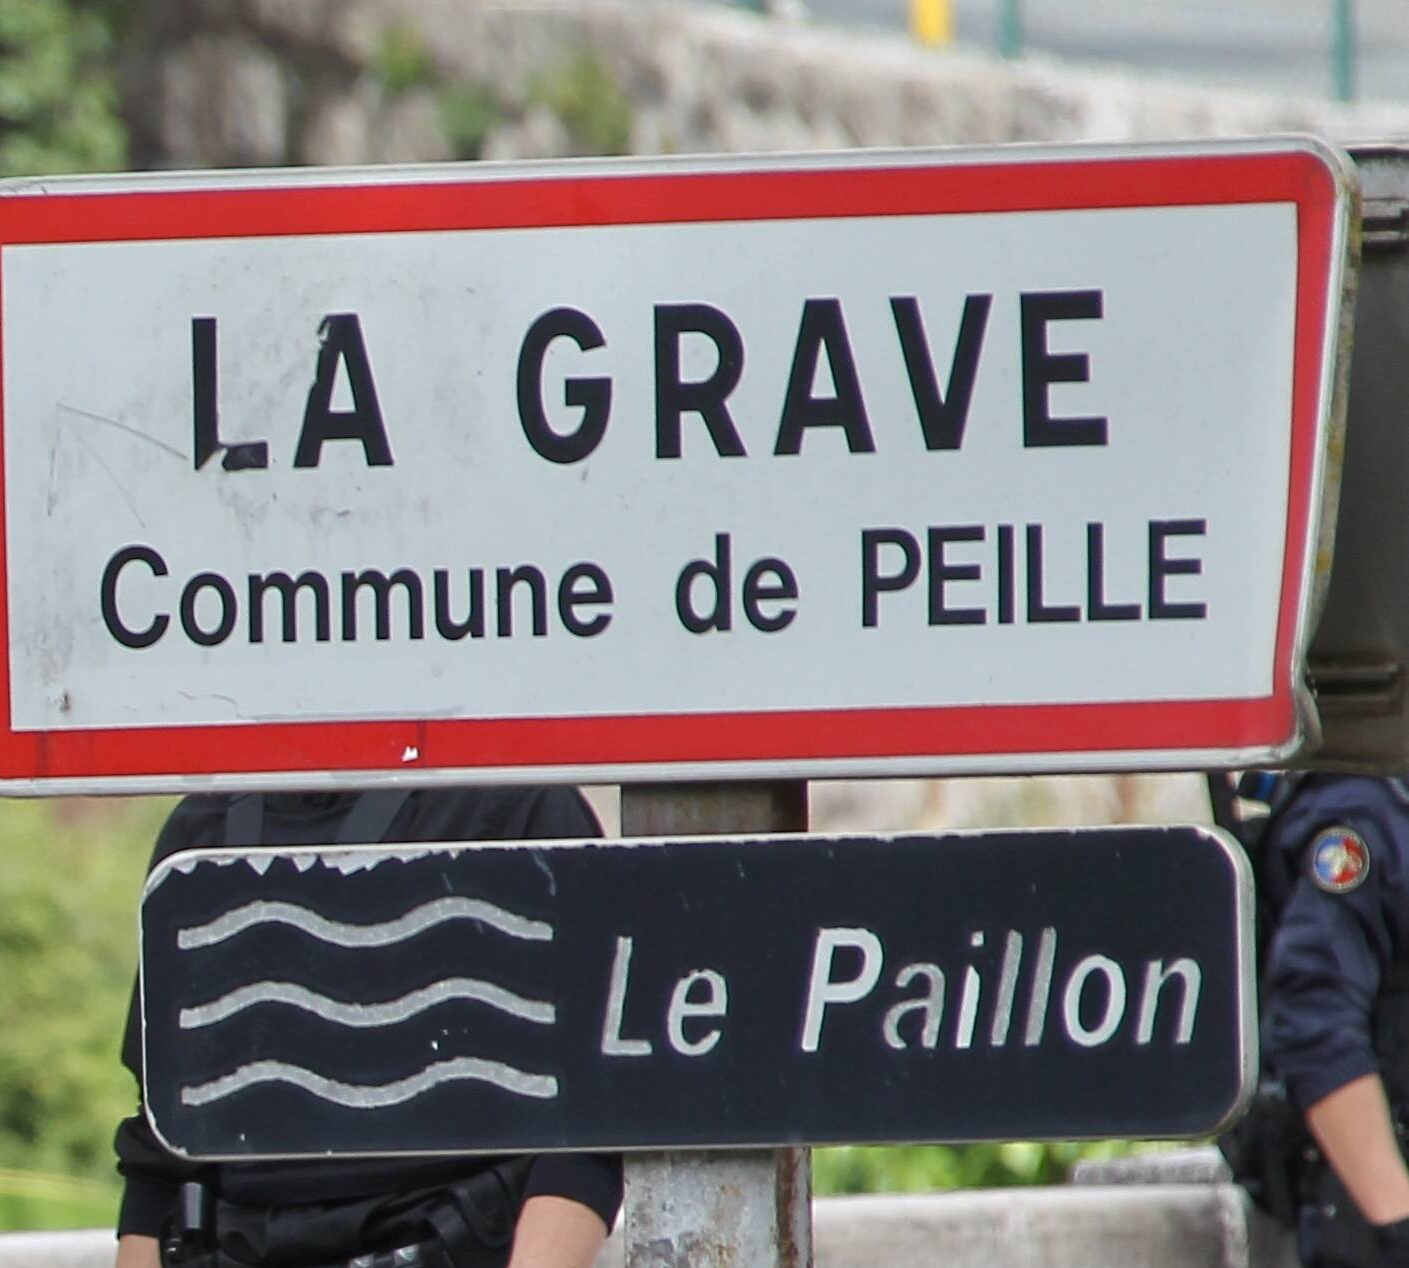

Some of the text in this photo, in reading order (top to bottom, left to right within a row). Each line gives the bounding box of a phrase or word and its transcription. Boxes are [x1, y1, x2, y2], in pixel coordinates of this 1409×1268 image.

[190, 289, 1109, 474] LA GRAVE
[99, 519, 1207, 650] Commune de PEILLE
[600, 926, 1202, 1057] Le Paillon
